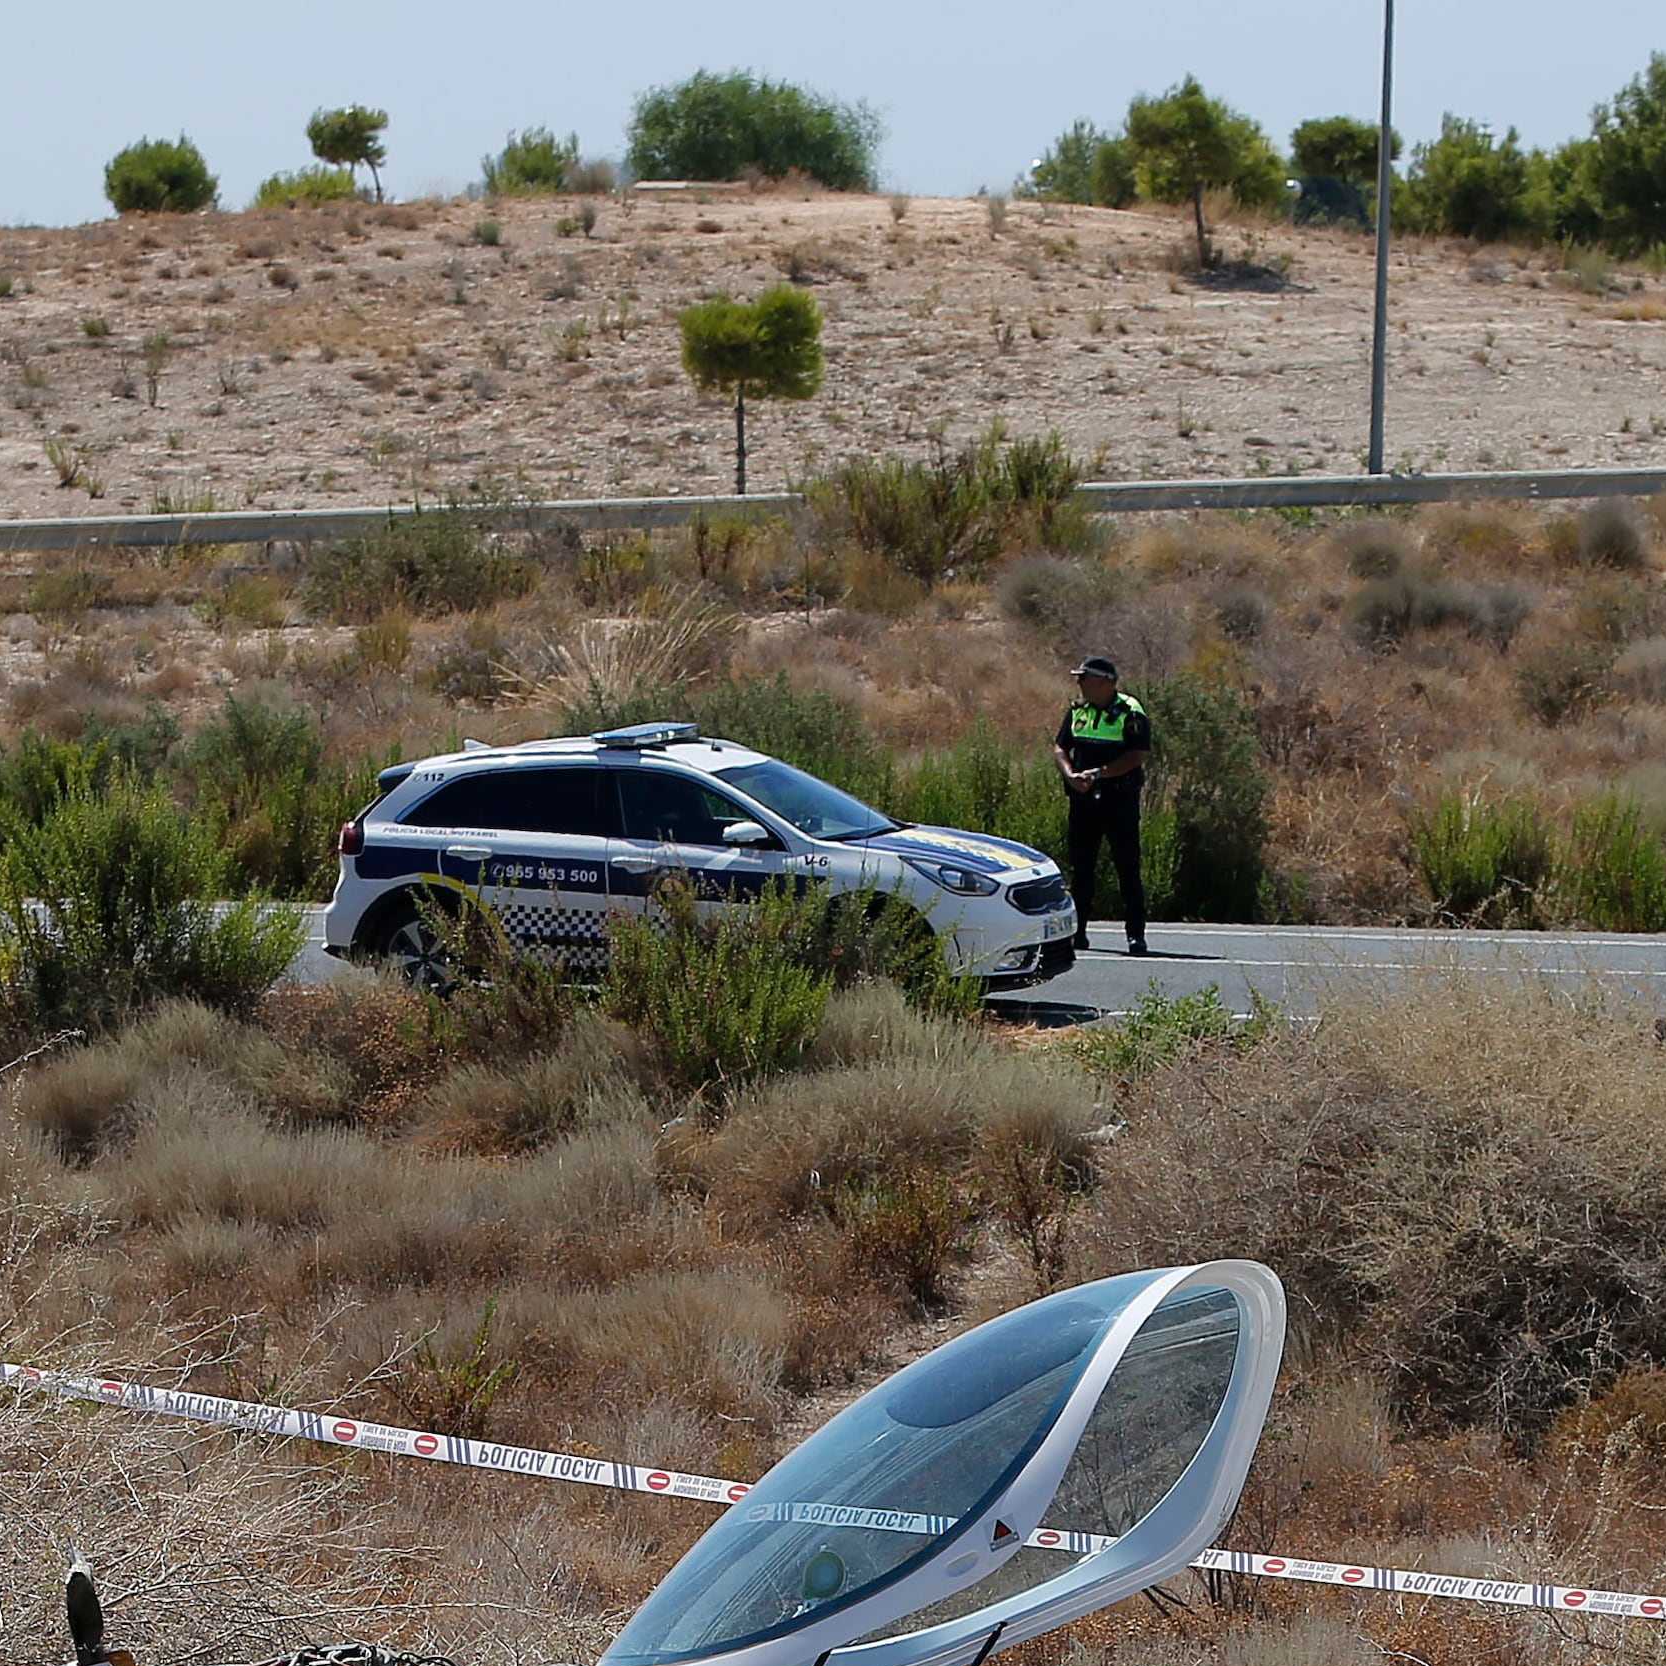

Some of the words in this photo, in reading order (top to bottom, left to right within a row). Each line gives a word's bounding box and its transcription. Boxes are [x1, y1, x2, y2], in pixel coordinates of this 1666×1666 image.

[423, 773, 445, 782] 112
[383, 826, 418, 835] POLICIA
[420, 828, 447, 836] LOCAL
[804, 855, 828, 867] V-6
[538, 868, 565, 881] 953
[570, 870, 597, 883] 500
